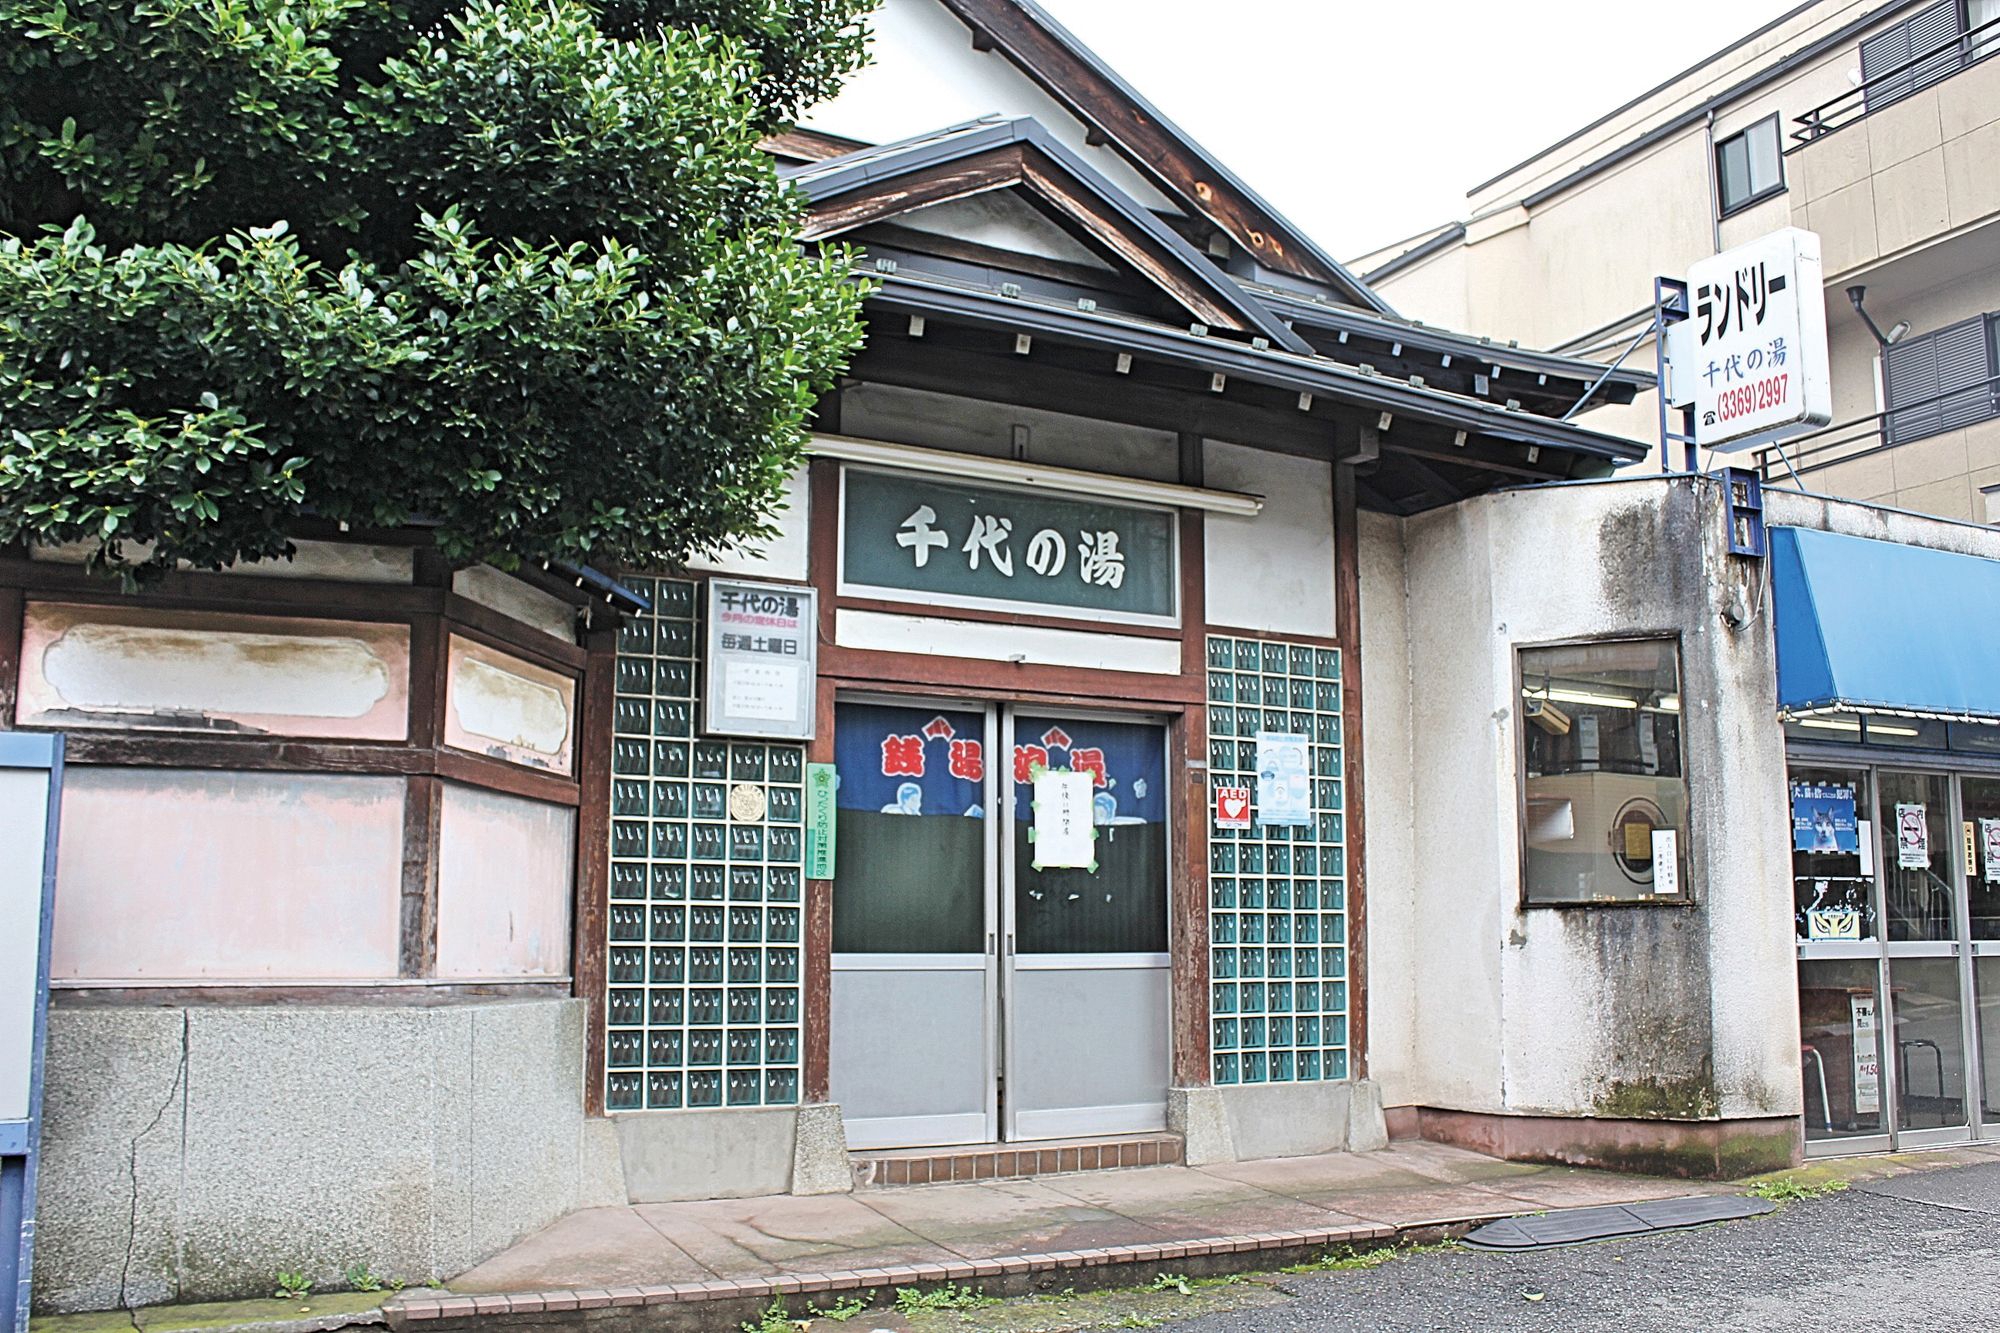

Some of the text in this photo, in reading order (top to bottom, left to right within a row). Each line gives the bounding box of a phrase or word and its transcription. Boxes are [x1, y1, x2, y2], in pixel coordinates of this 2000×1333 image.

[1697, 261, 1786, 347] ランドリー
[1702, 336, 1787, 389] 千代の湯
[1717, 373, 1788, 424] (3369)2997
[895, 504, 1126, 590] 千代の湯
[720, 591, 799, 618] 千代の湯
[721, 612, 798, 628] 今月の定休日は
[721, 632, 798, 655] 毎週土曜日
[1219, 788, 1248, 799] AED
